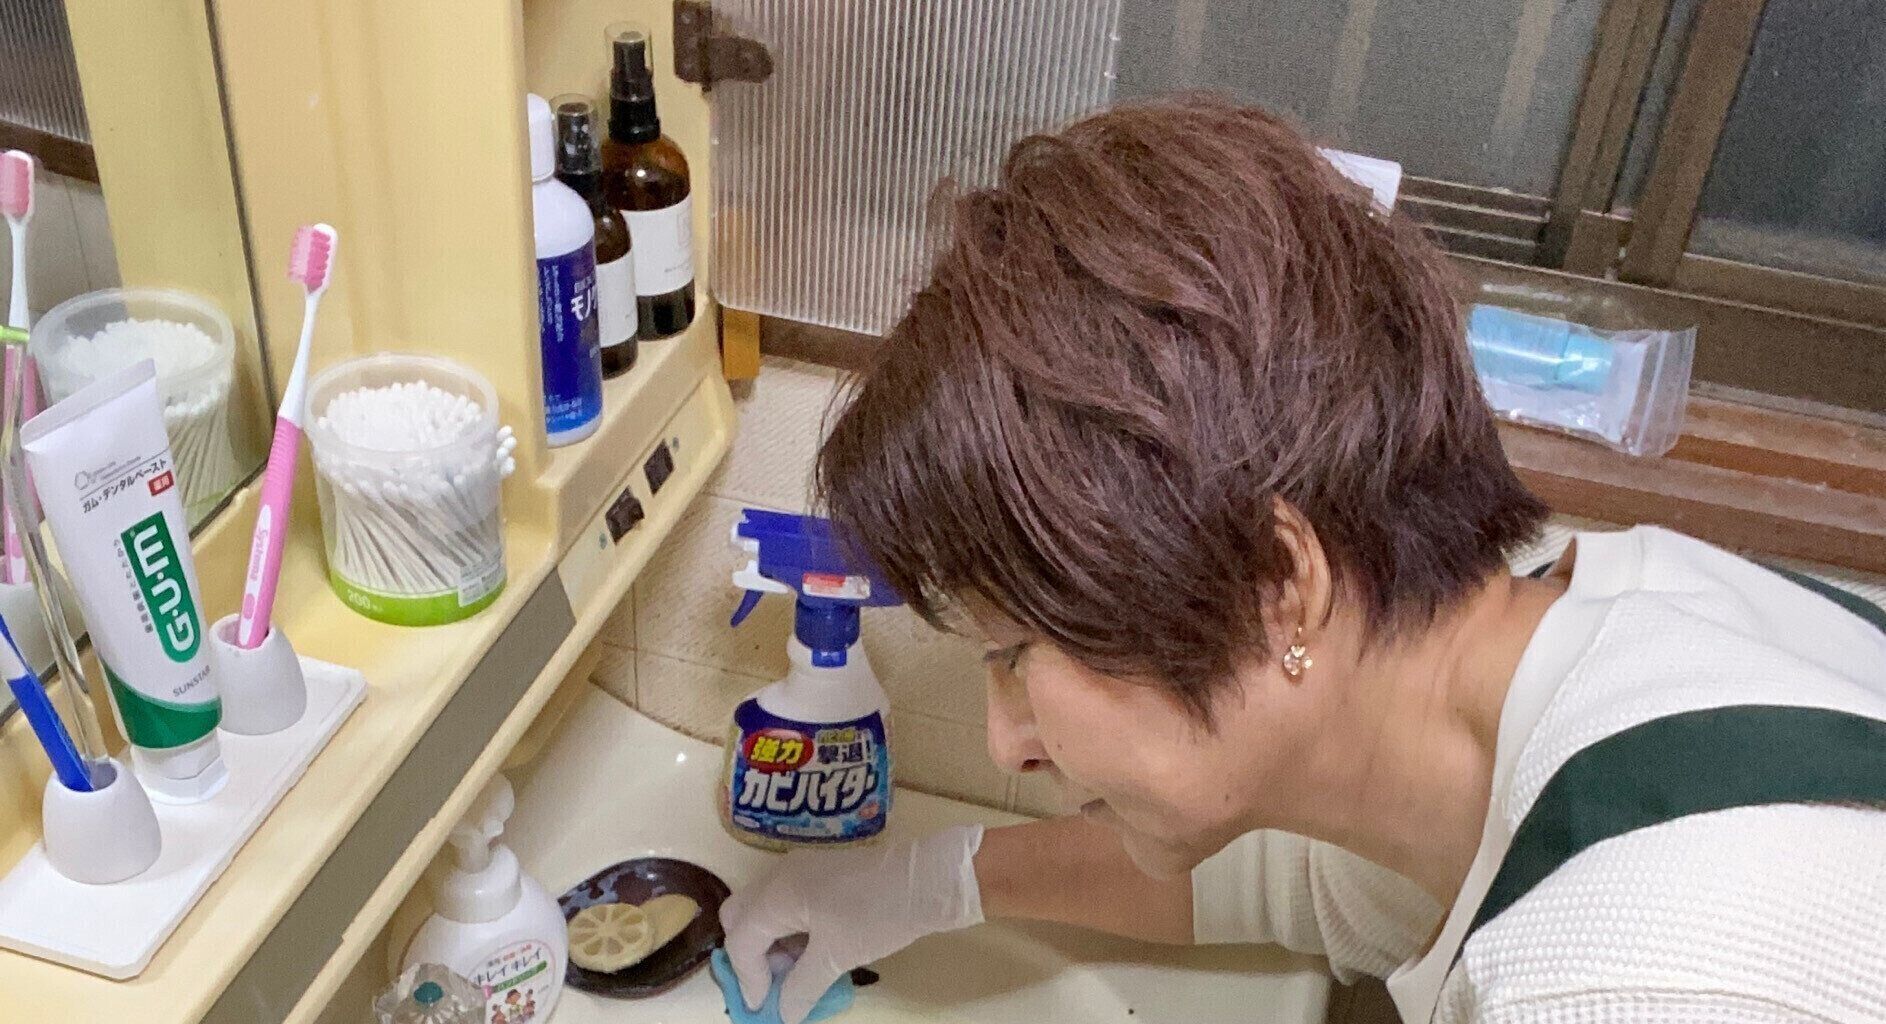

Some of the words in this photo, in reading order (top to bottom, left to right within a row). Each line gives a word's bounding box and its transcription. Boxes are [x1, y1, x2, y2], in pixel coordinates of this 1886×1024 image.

[172, 664, 211, 698] SUNSTAR
[751, 736, 804, 765] 強力
[738, 765, 875, 812] カビハイター
